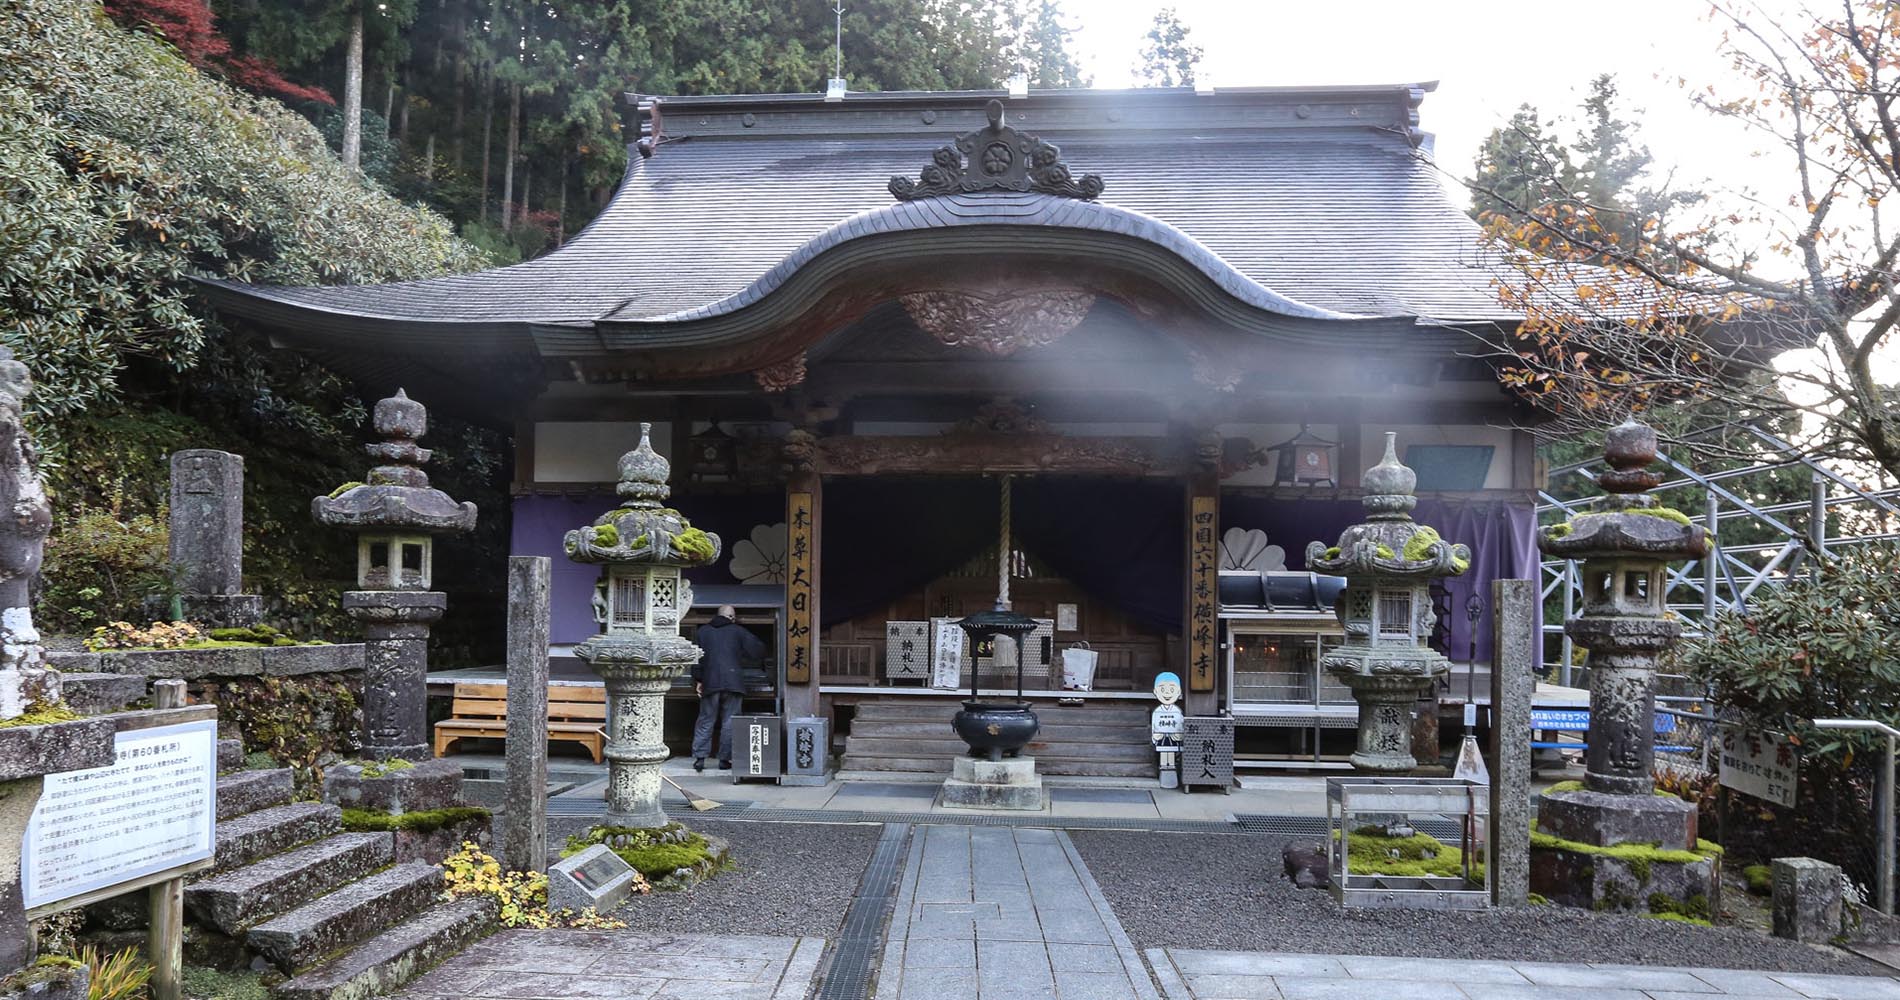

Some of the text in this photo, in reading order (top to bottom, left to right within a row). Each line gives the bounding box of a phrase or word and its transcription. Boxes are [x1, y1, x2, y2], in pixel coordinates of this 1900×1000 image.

[115, 742, 181, 761] 寺(第60番札所)
[1200, 739, 1216, 779] 納札入
